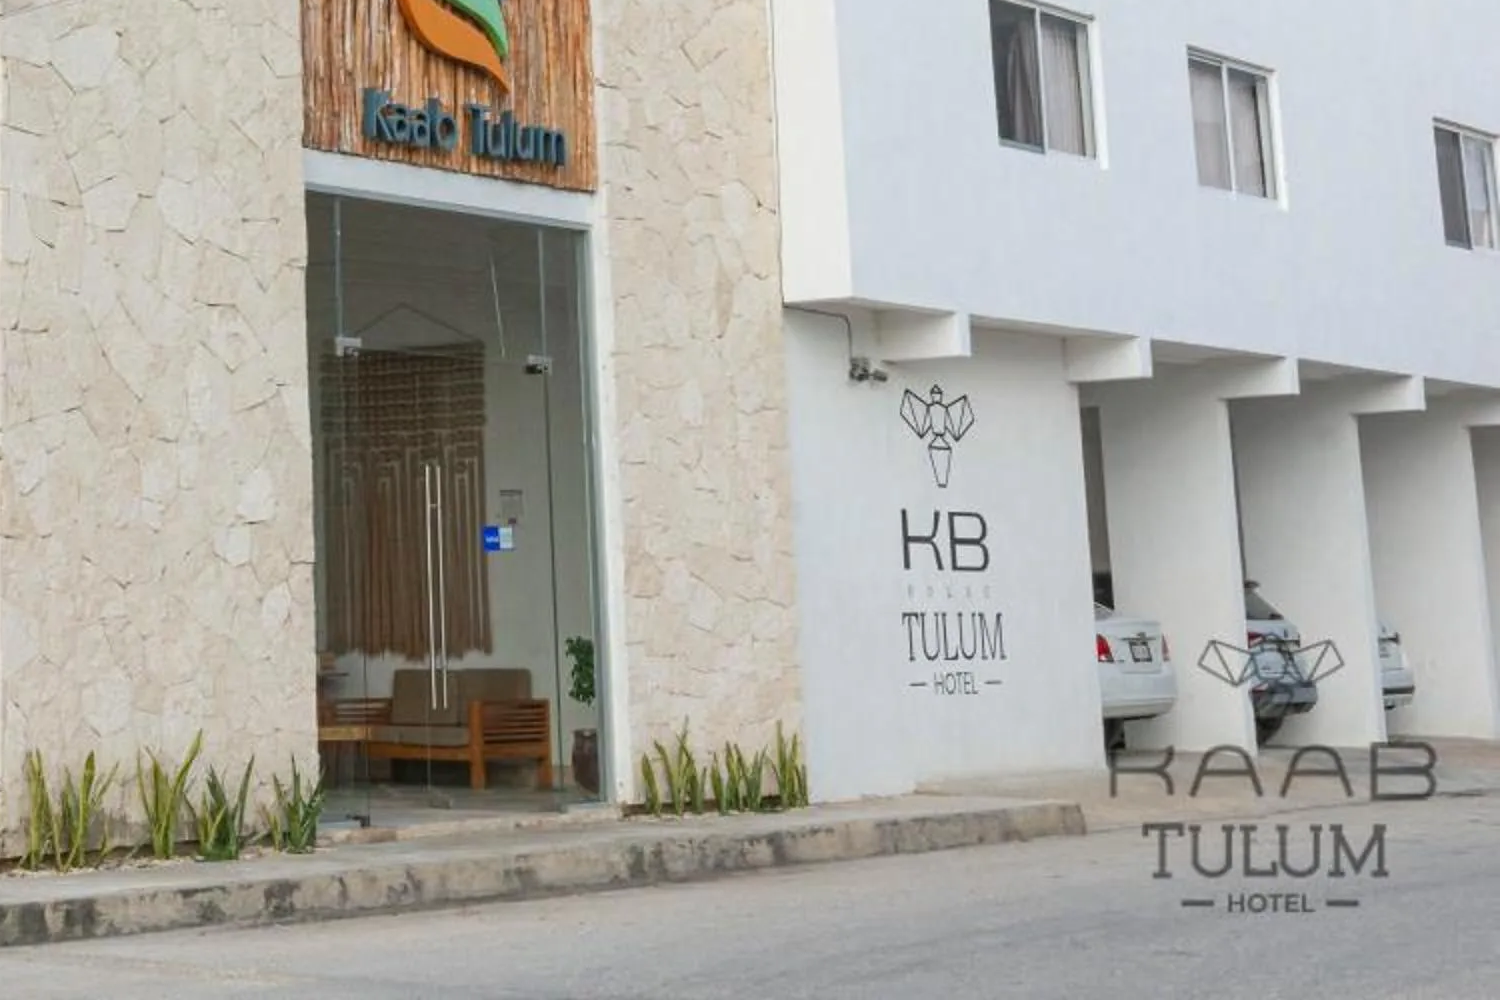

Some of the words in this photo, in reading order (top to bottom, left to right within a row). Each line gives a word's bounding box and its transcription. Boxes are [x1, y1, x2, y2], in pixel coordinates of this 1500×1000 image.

[362, 87, 459, 151] Kaab
[468, 103, 567, 168] Tulum
[901, 508, 990, 572] KB
[902, 611, 1007, 662] TULUM
[933, 671, 979, 696] HOTEL
